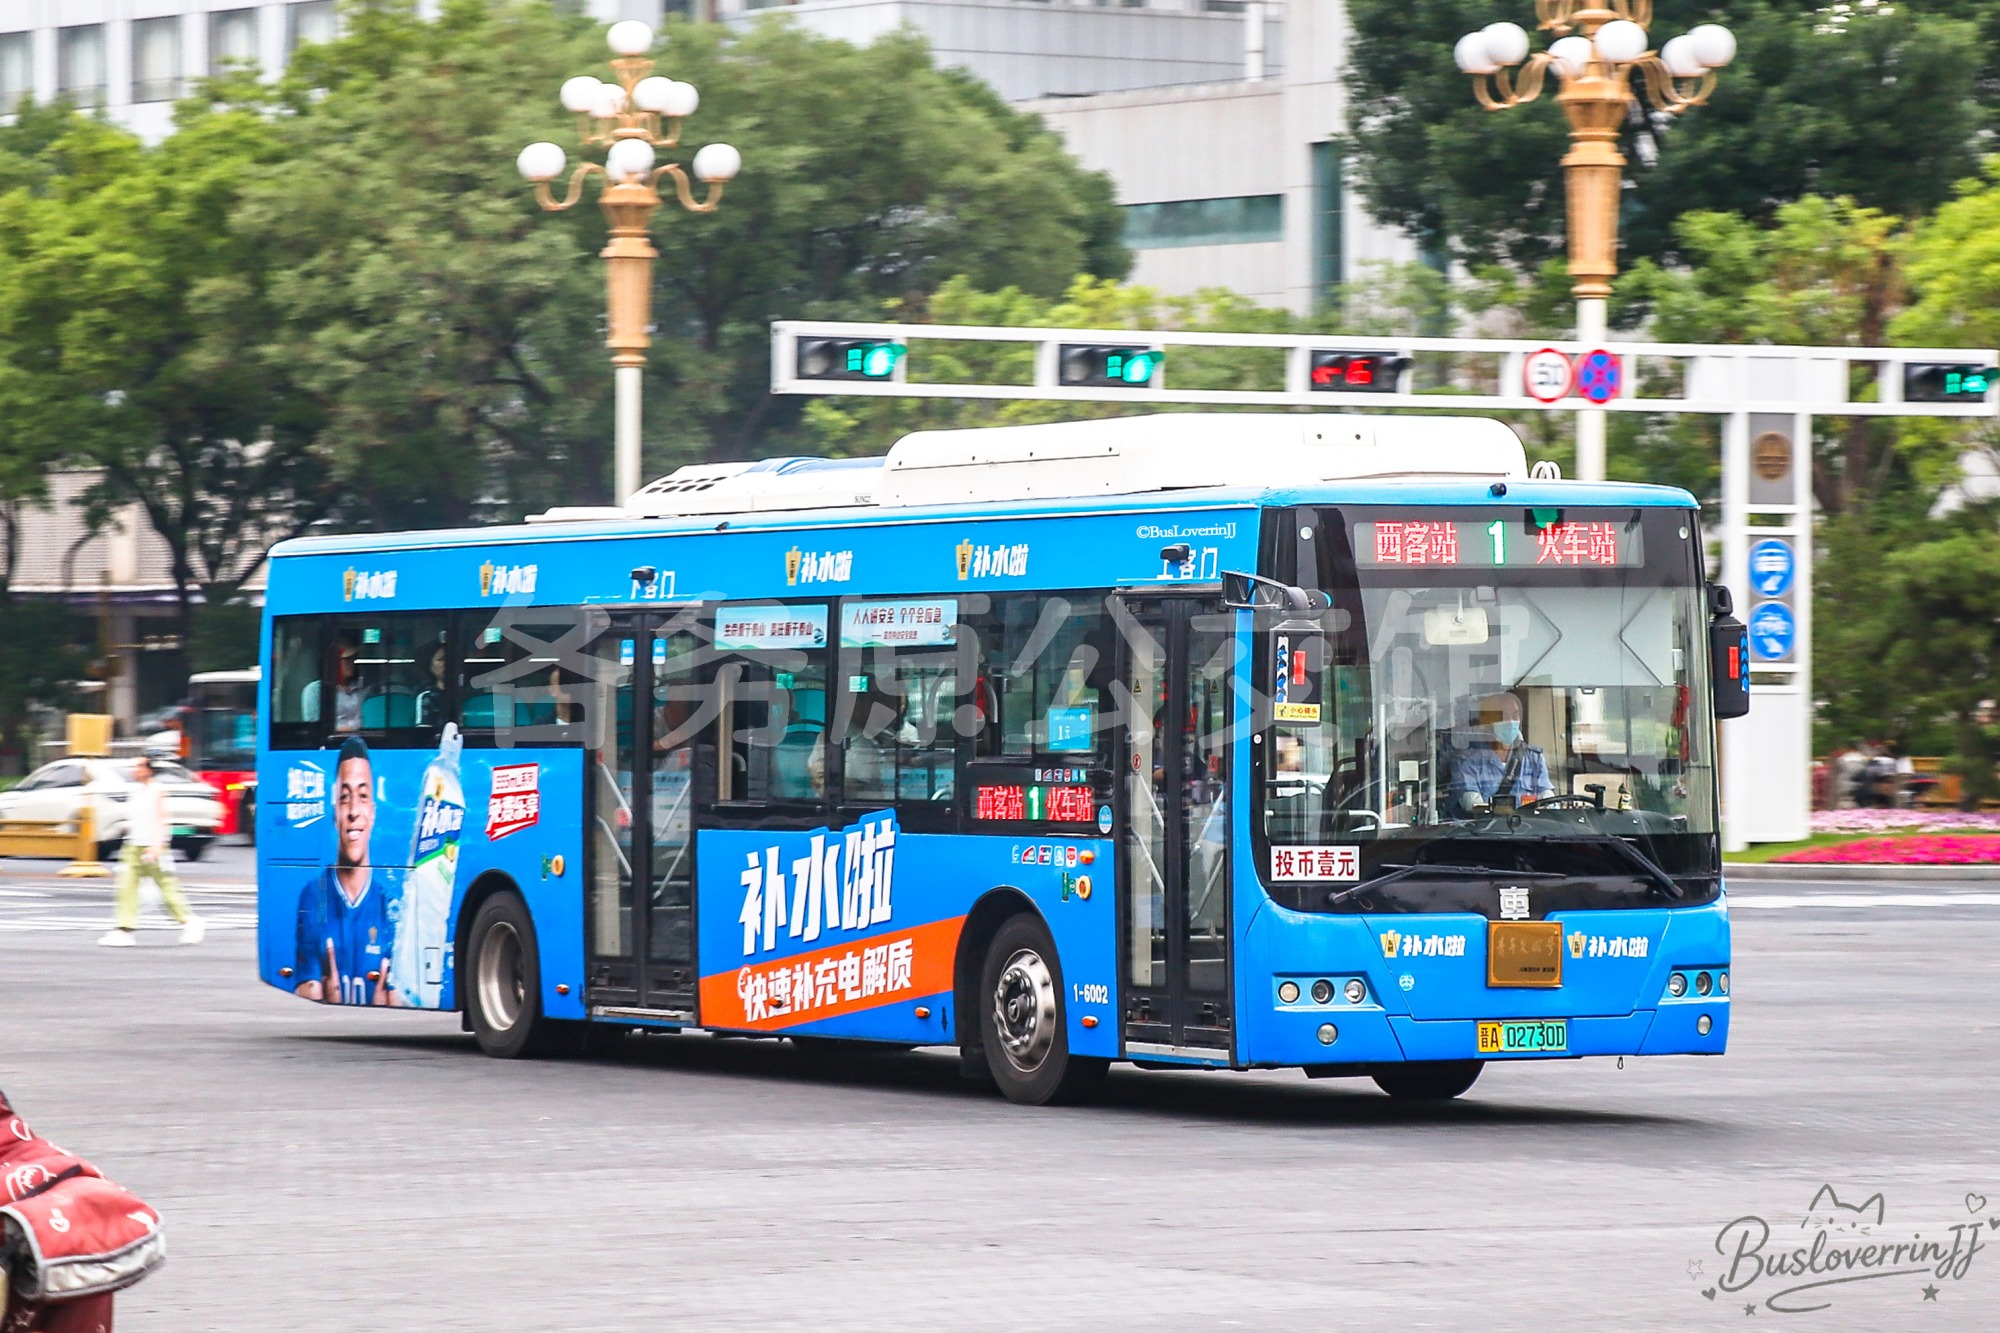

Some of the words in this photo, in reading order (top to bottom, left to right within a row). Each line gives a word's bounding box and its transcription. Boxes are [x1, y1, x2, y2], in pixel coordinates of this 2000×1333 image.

[1374, 520, 1457, 564] 西客站
[1487, 520, 1505, 565] 1
[1536, 521, 1616, 565] 火车站
[801, 550, 853, 583] 补水啦
[973, 543, 1029, 578] 补水啦
[853, 607, 895, 624] 人人讲安全
[900, 606, 942, 624] 个个会应急
[977, 786, 1023, 819] 西客站
[1028, 785, 1040, 820] 1
[1046, 786, 1093, 821] 火车站
[1275, 850, 1355, 877] 投币壹元
[738, 817, 896, 956] 补水啦
[1402, 934, 1466, 957] 补水啦
[1588, 936, 1649, 958] 补水啦
[743, 938, 914, 1023] 快速补充电解质
[1073, 983, 1109, 1004] 1-6002
